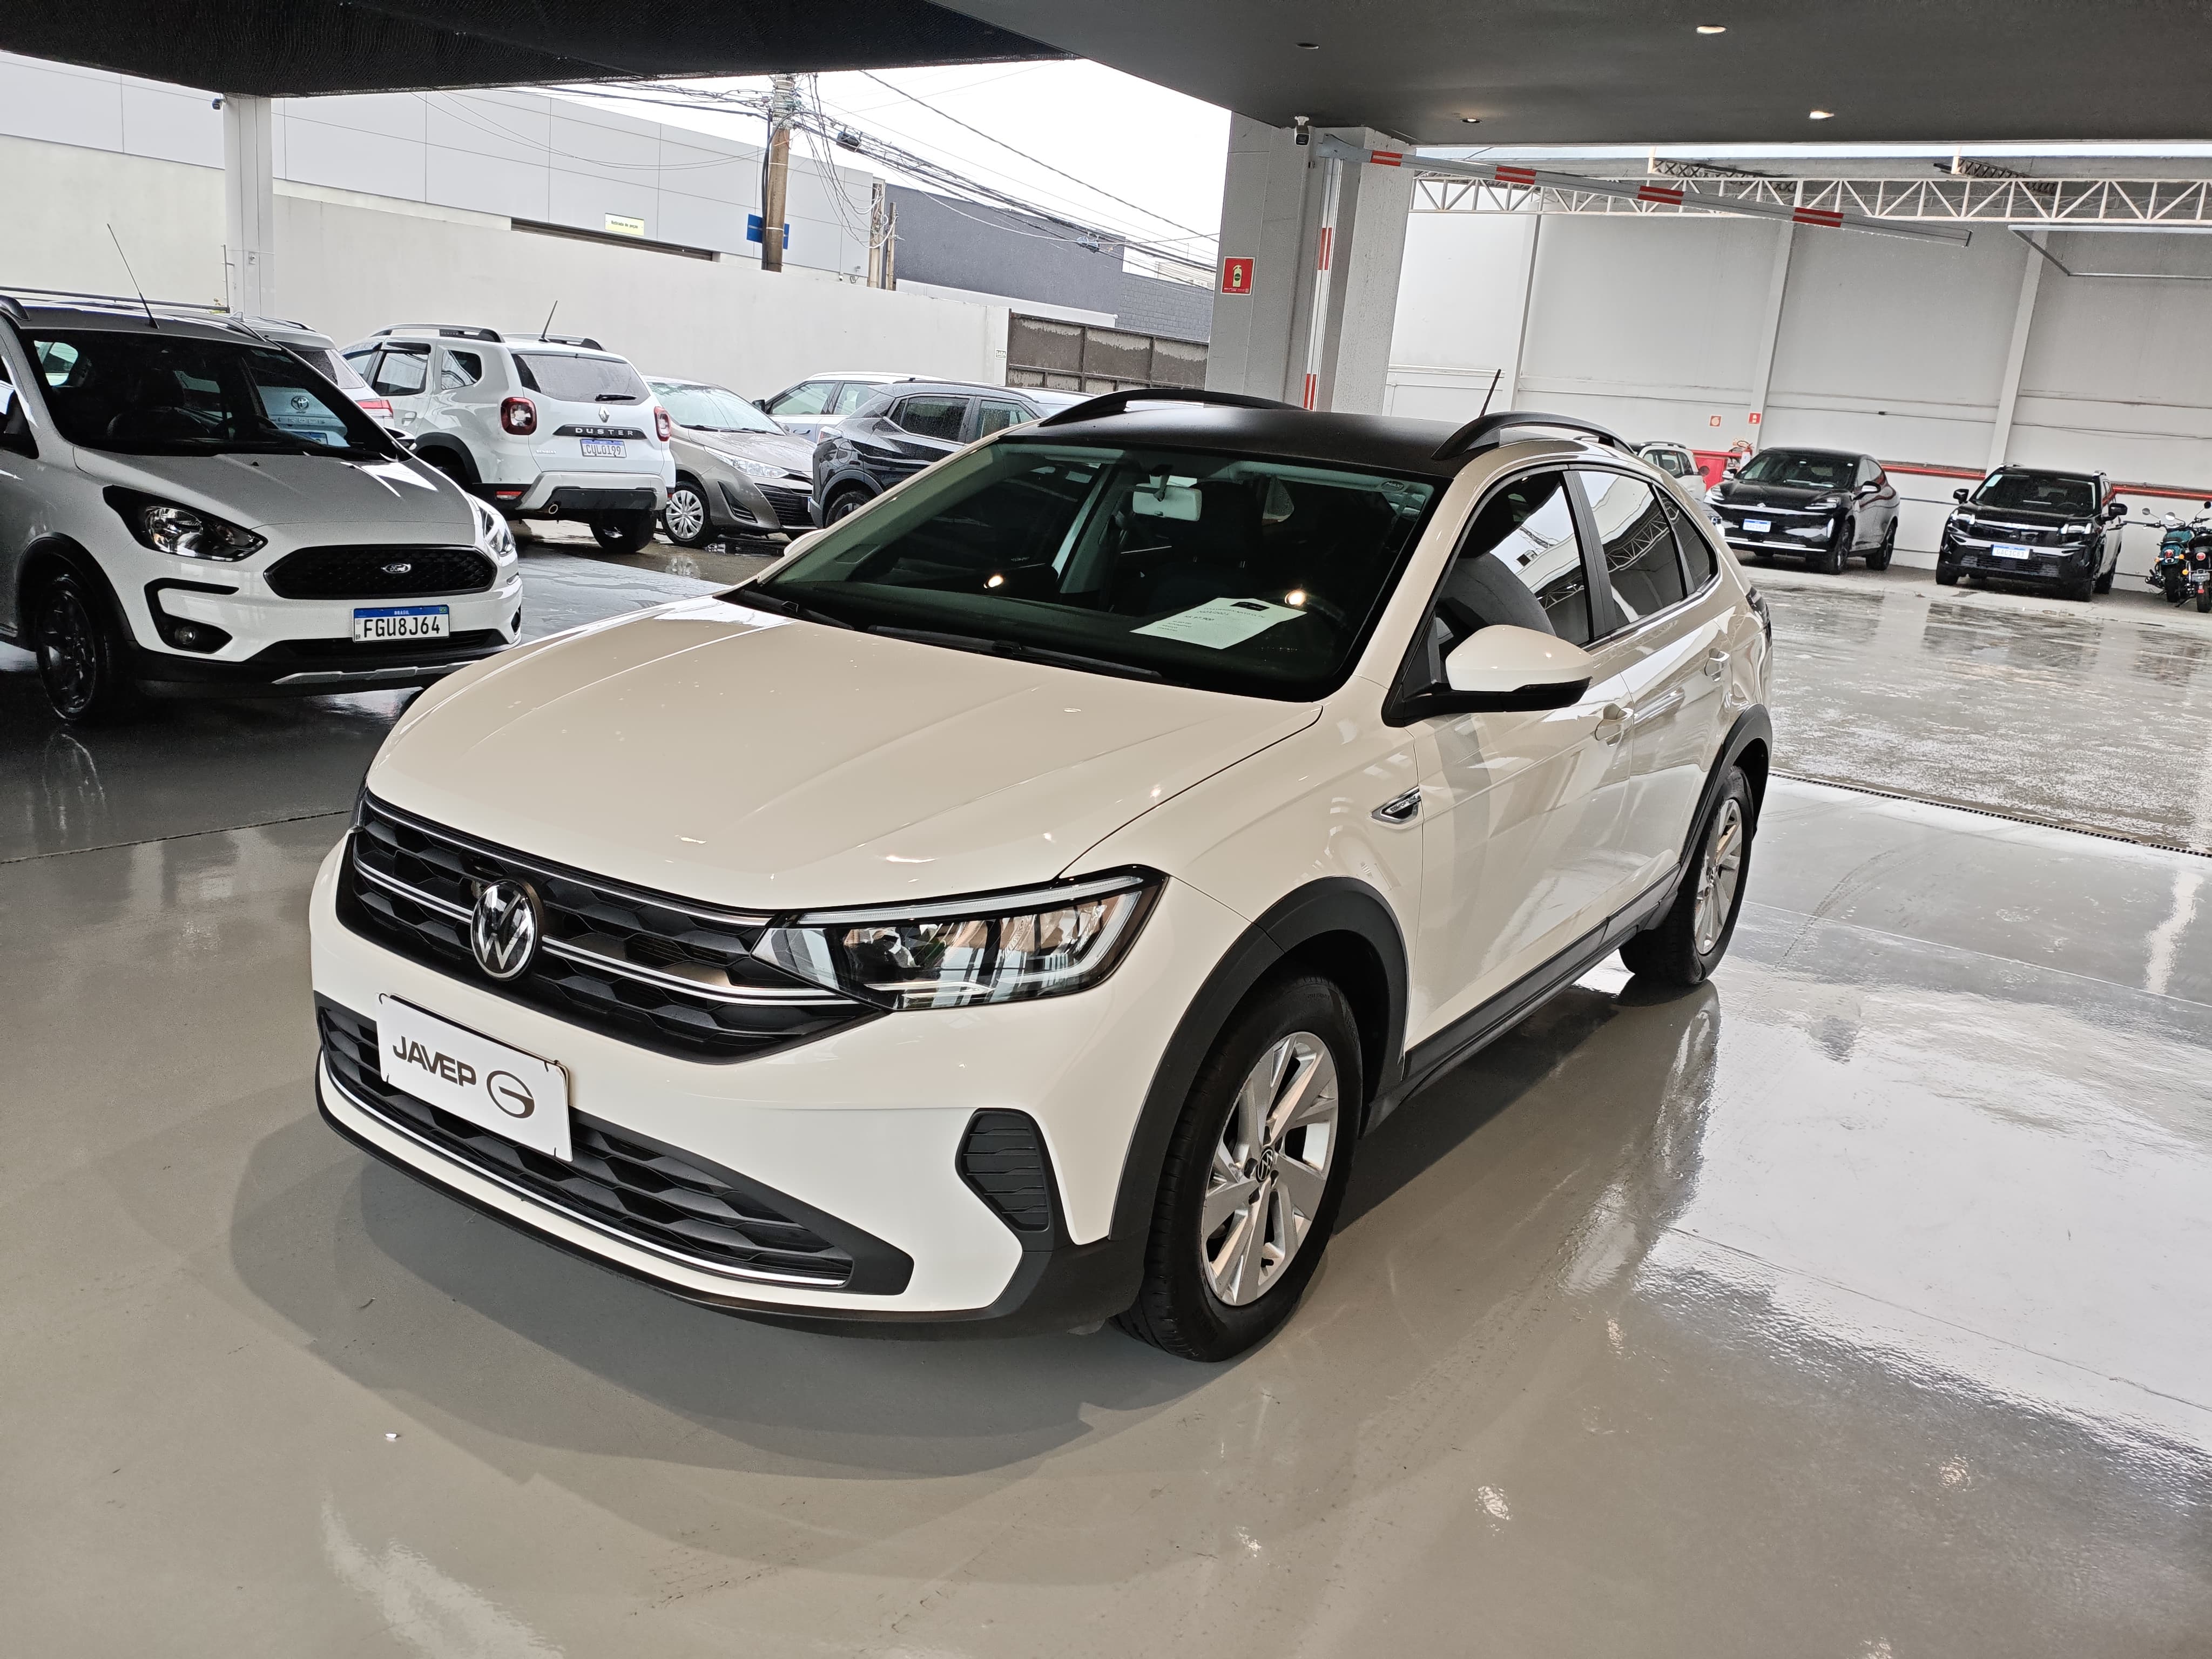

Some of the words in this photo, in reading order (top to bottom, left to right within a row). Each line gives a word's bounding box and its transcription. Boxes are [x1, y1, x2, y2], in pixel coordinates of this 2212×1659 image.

[575, 428, 633, 436] DUSTER
[364, 616, 440, 638] FGU8J64
[393, 1035, 476, 1087] JAVEP
